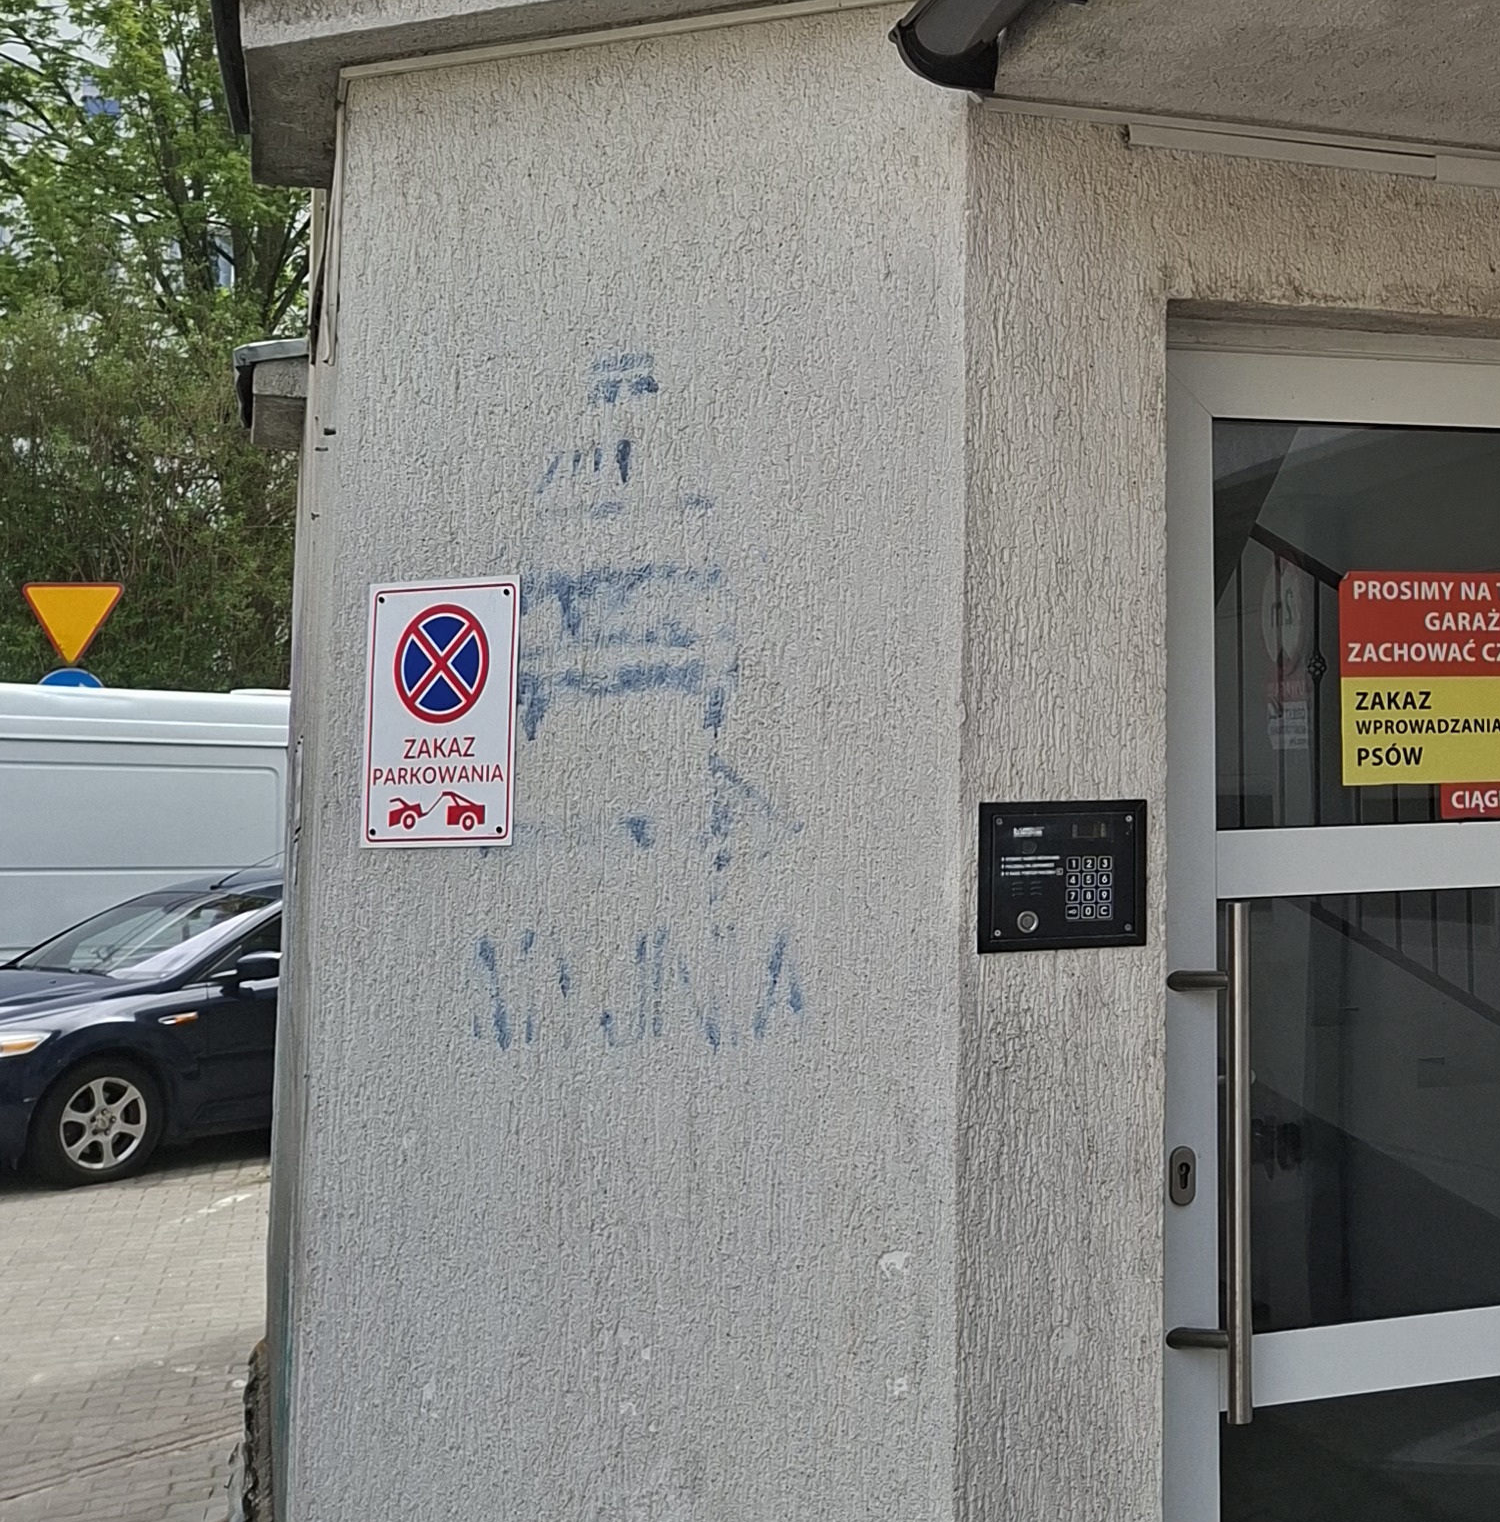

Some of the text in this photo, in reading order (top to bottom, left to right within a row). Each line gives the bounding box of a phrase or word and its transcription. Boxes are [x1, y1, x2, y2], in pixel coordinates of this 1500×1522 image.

[1353, 580, 1454, 601] PROSIMY
[1460, 582, 1491, 601] NA
[1348, 639, 1476, 663] ZACHOWAĆ
[1355, 691, 1432, 711] ZAKAZ
[403, 736, 476, 759] ZAKAZ
[1357, 743, 1423, 767] PSÓW
[373, 763, 504, 786] PARKOWANIA
[1085, 859, 1093, 868] 2
[1101, 858, 1109, 868] 3
[1069, 874, 1108, 884] 4 5 6
[1069, 890, 1108, 900] 7 8 9
[1085, 906, 1108, 916] 0 C
